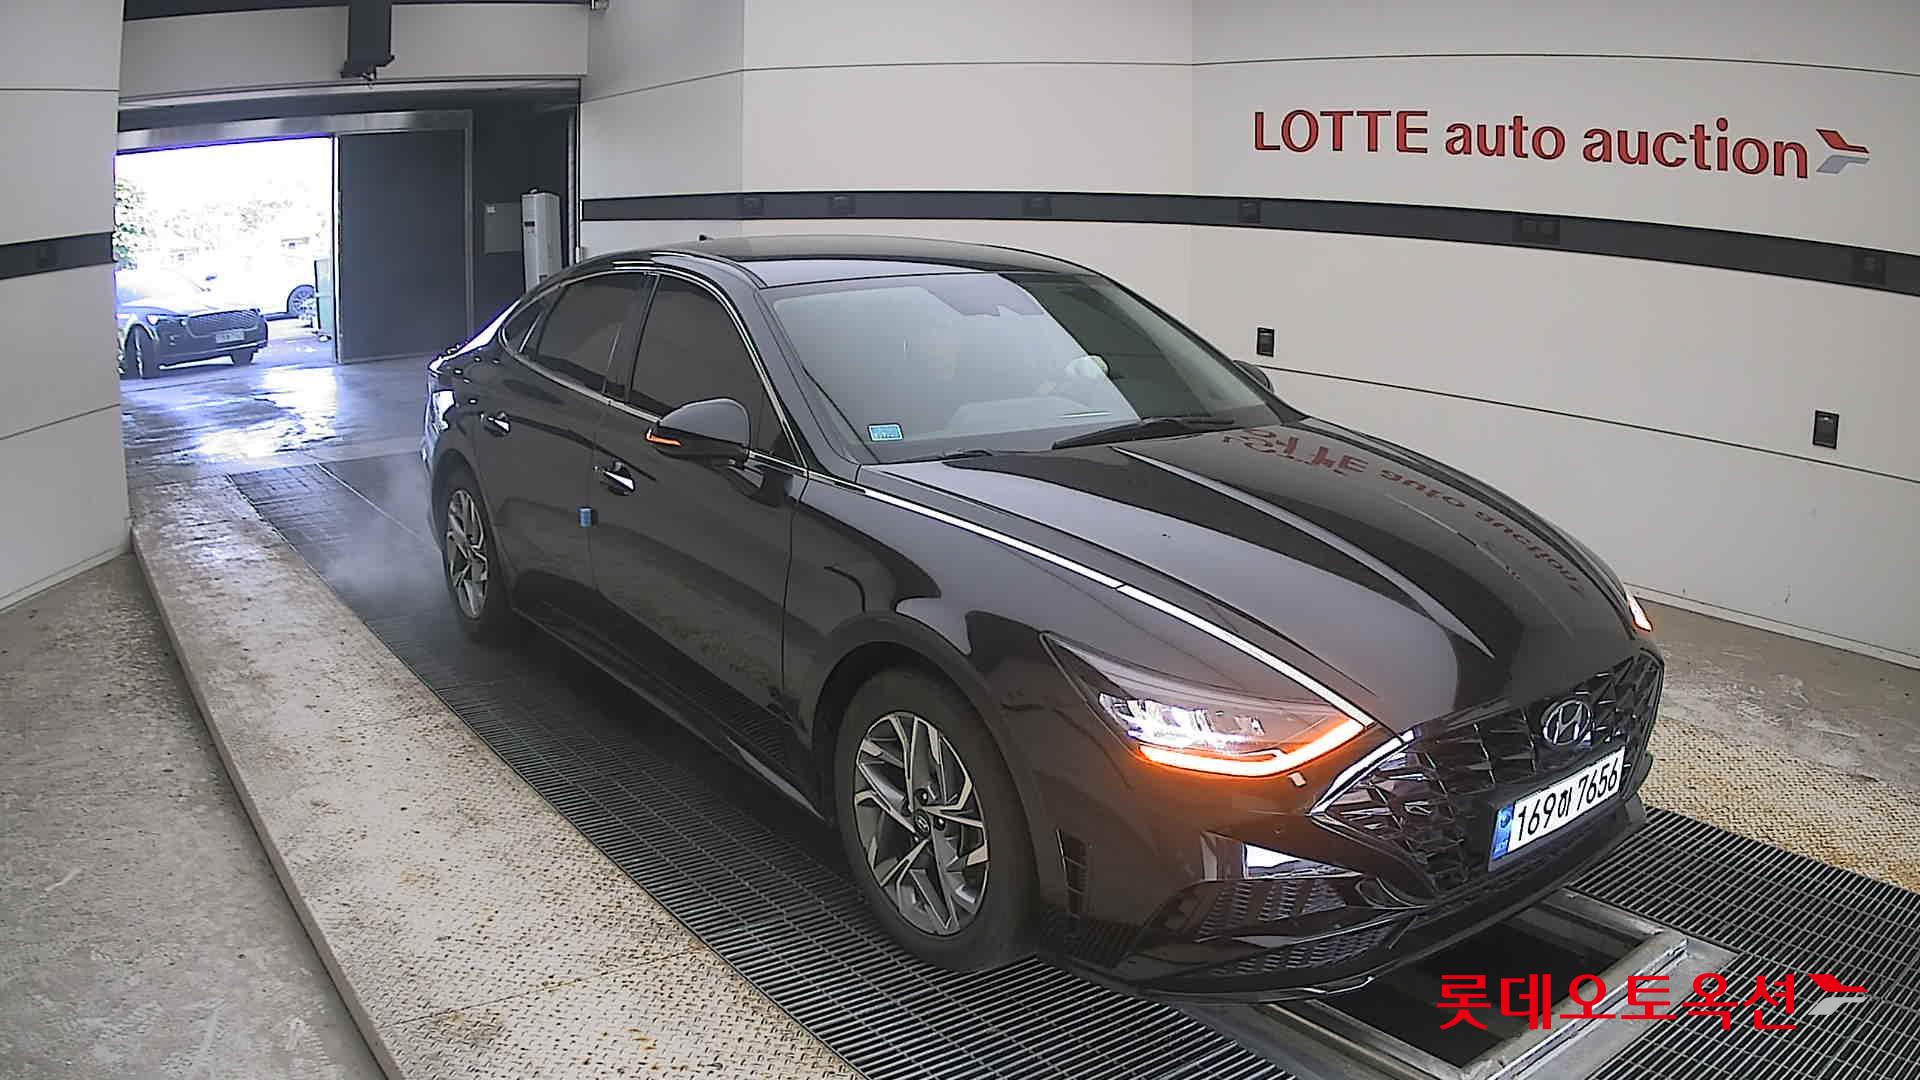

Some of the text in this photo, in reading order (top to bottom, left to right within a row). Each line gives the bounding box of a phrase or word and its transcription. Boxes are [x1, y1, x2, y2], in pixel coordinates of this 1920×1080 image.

[1254, 110, 1809, 179] LOTTE auto auction
[1576, 757, 1618, 811] 7656
